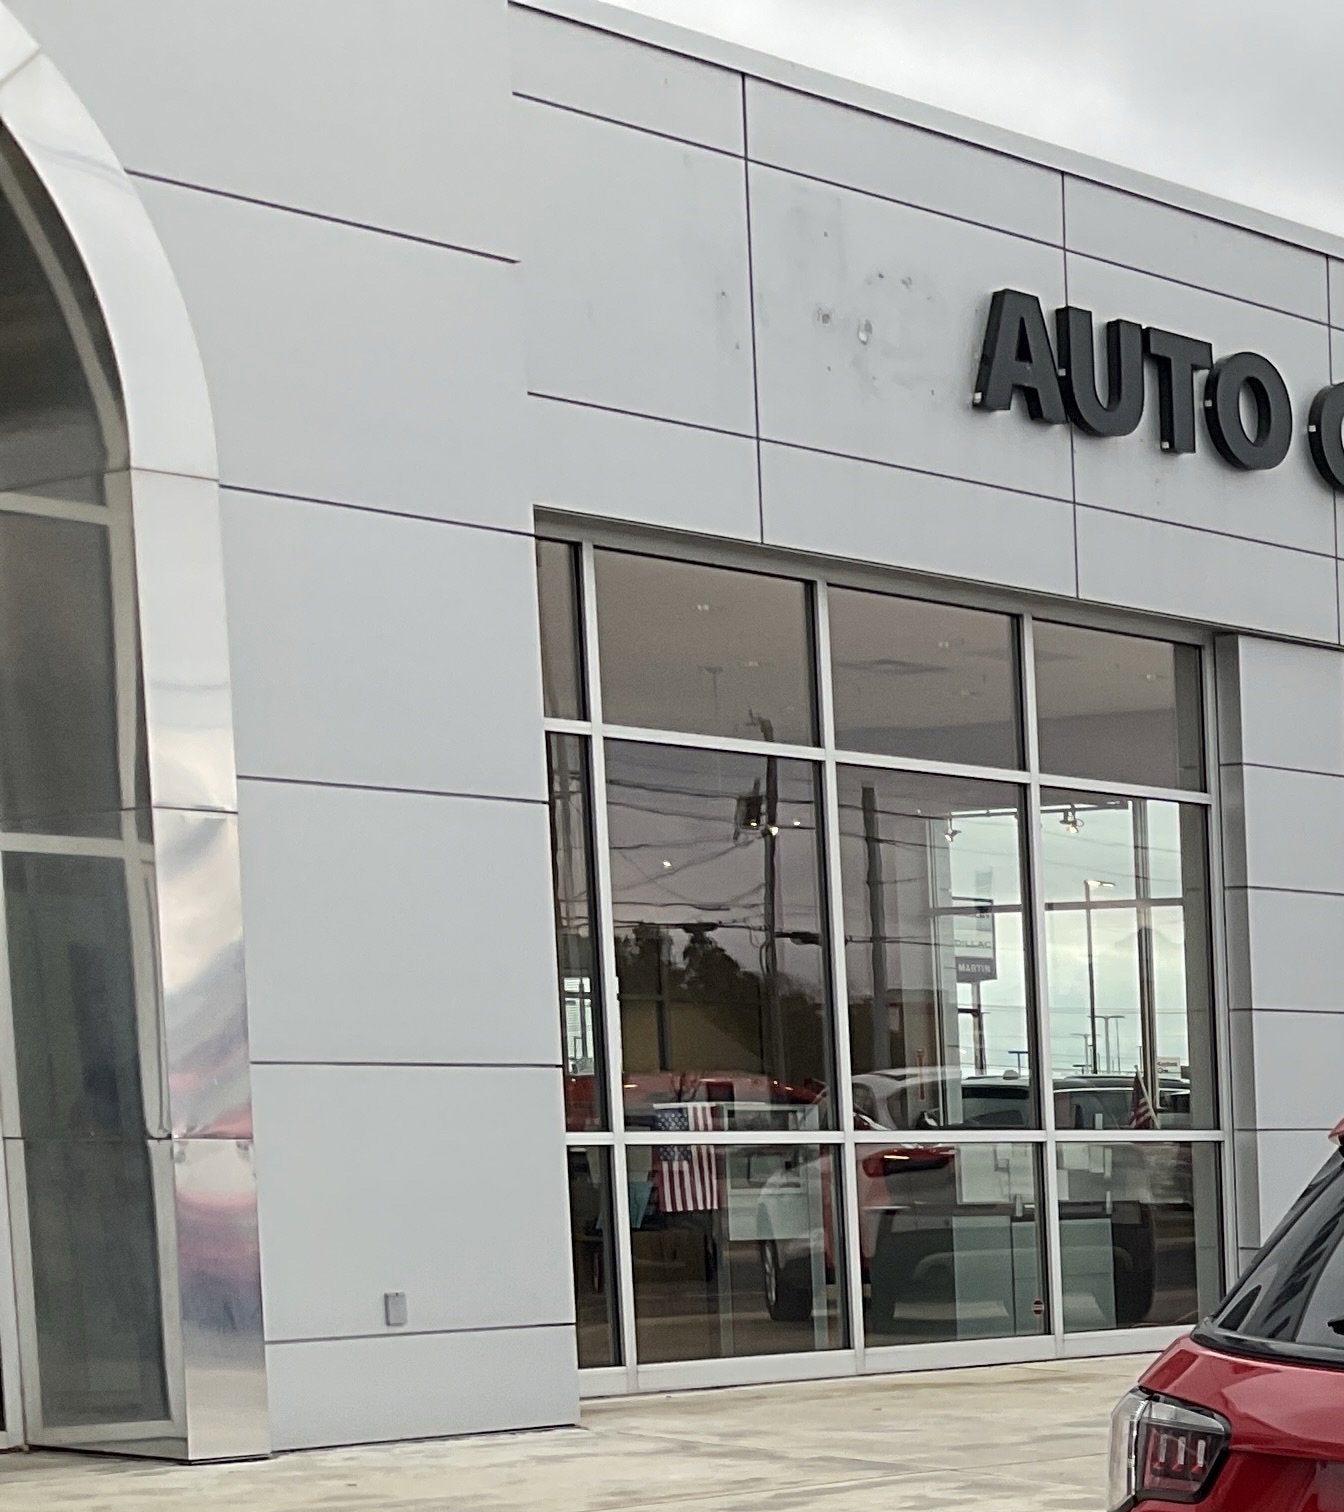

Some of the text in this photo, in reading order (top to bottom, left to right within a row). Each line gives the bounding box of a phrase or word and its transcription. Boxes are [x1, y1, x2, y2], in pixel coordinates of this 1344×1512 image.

[972, 288, 1293, 471] AUTO
[955, 940, 992, 949] DILLAC
[958, 963, 991, 973] MARTIN
